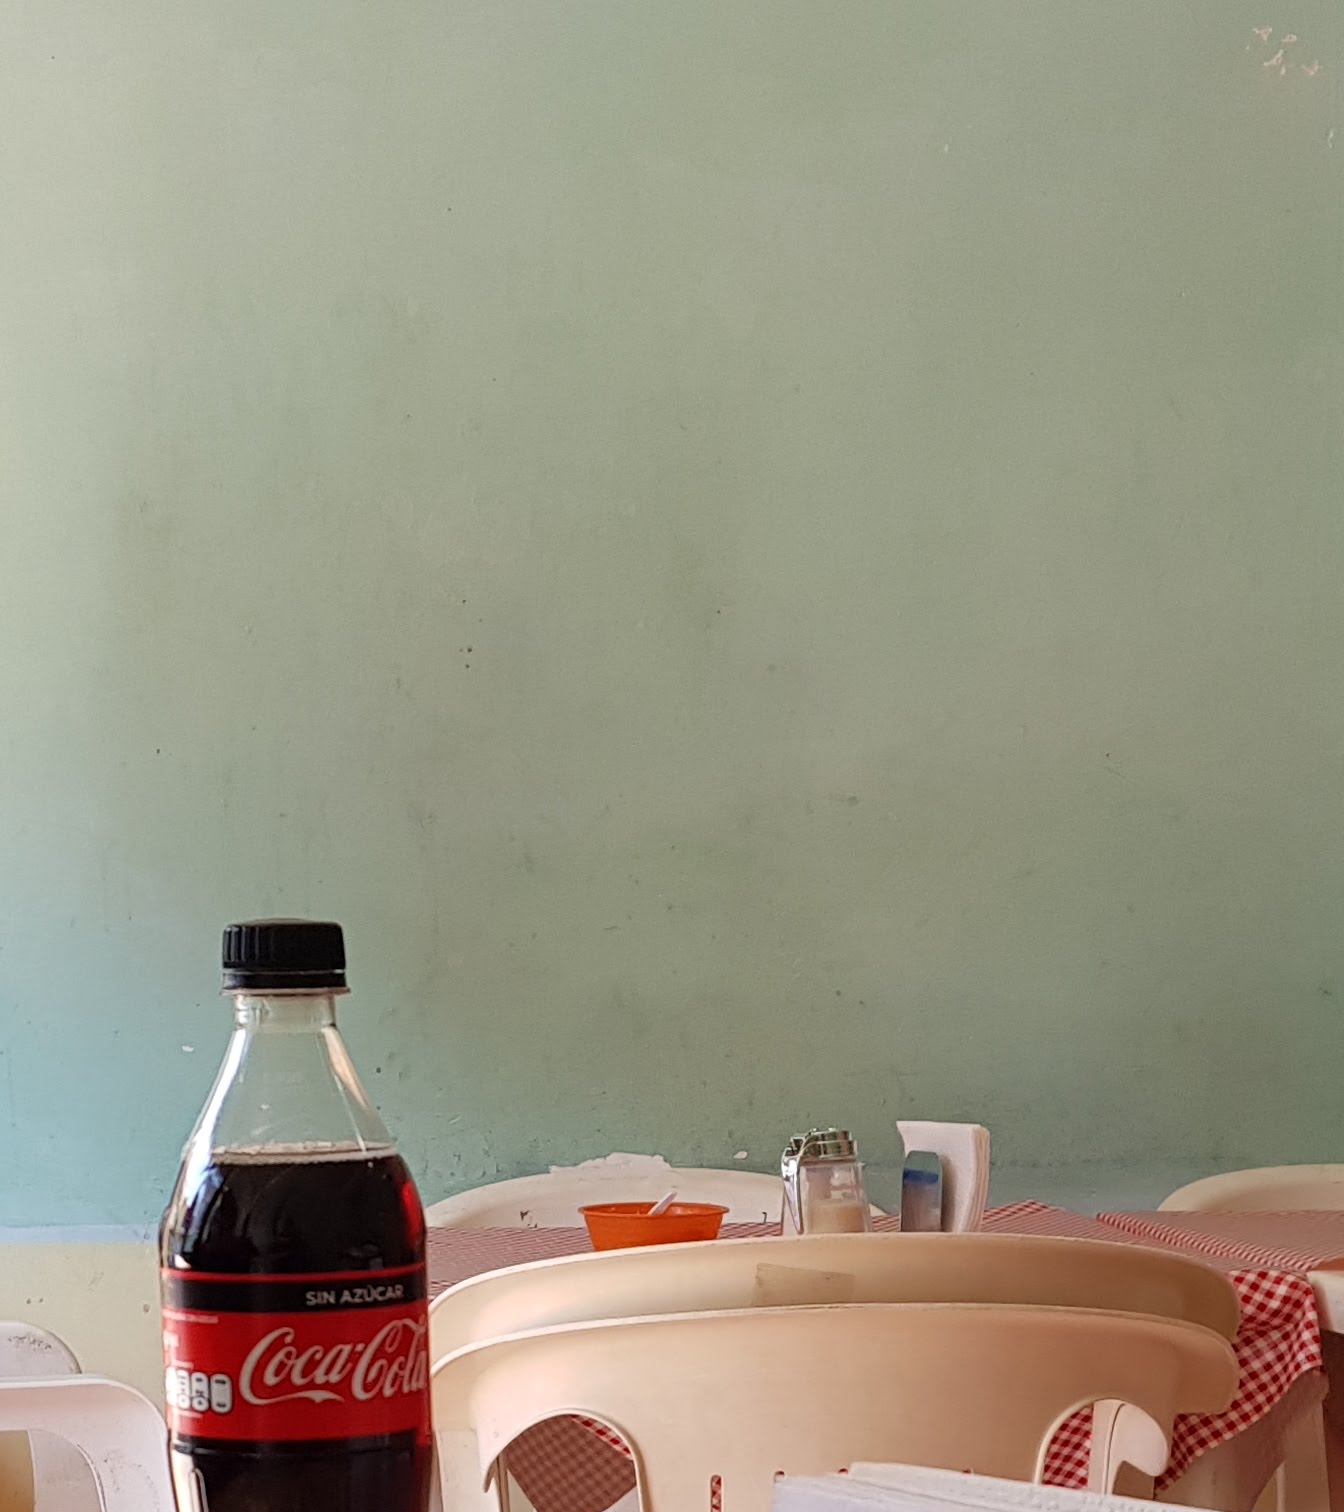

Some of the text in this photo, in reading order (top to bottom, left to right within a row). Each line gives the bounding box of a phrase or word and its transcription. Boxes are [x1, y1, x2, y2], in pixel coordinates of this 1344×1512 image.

[305, 1284, 405, 1307] SIN AZÚCAR
[238, 1314, 428, 1406] Coca-Cola
